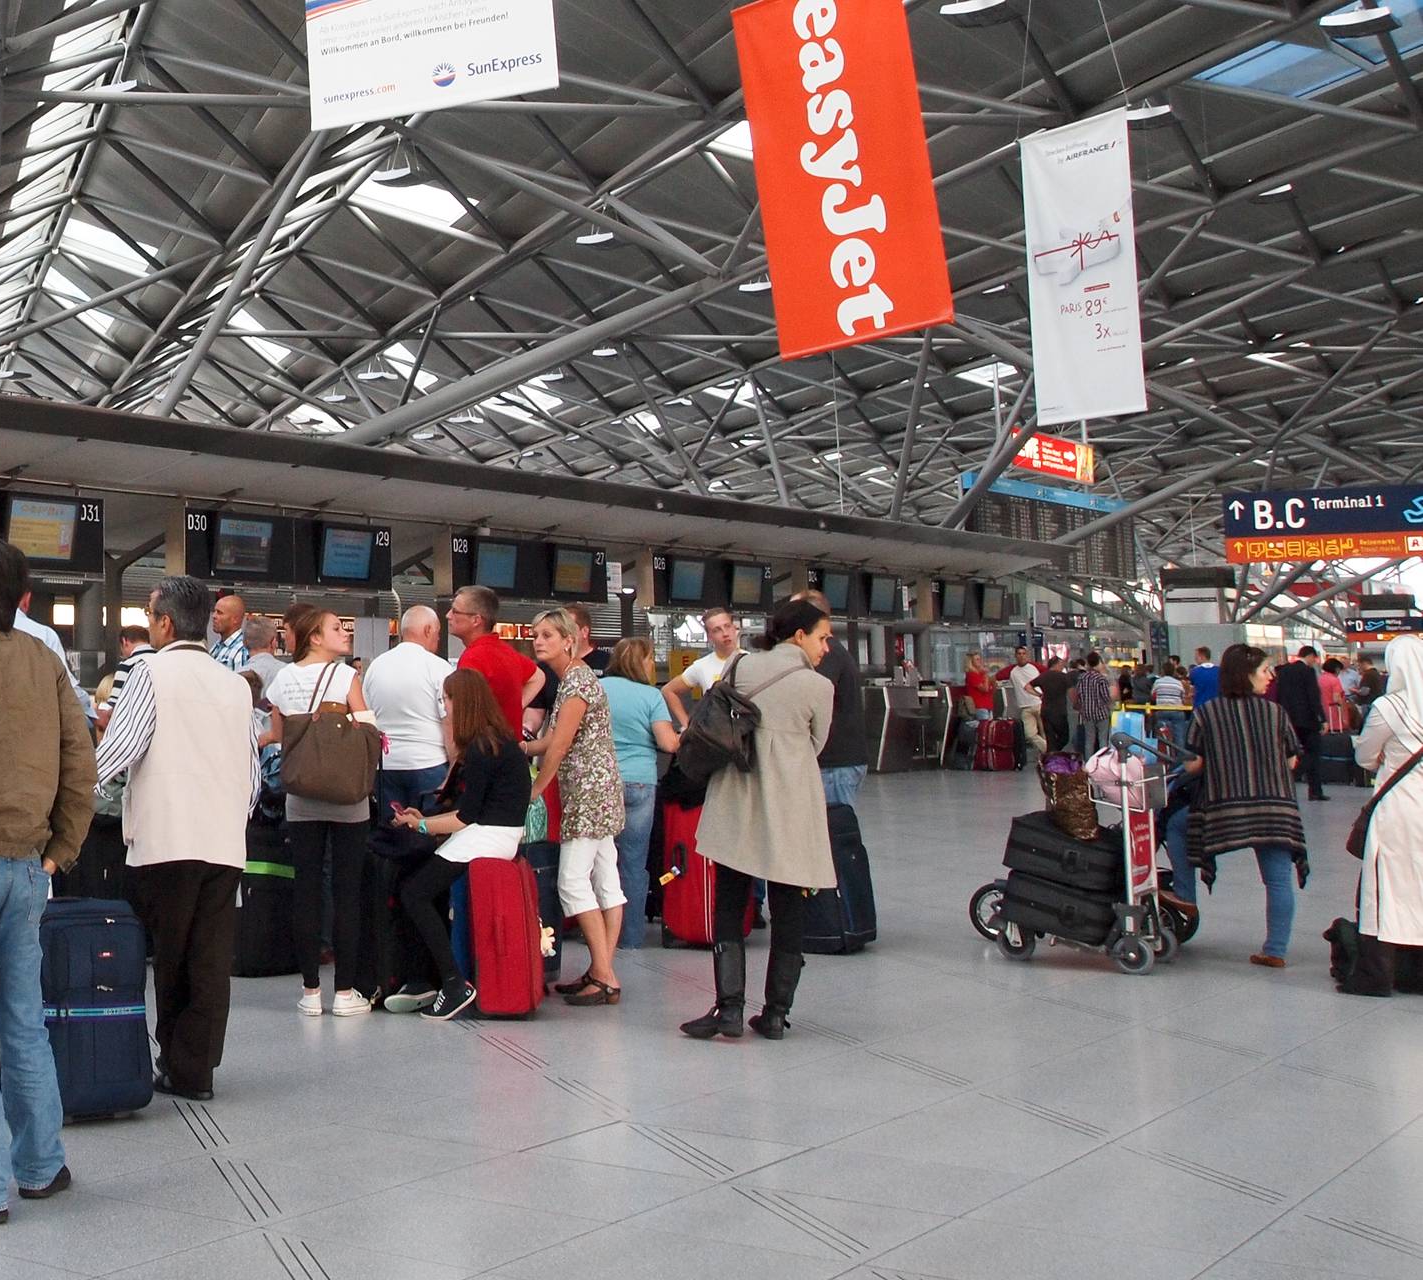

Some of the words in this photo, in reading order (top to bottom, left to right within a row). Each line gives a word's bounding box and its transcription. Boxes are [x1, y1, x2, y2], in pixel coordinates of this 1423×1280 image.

[320, 41, 368, 56] Willkommen
[370, 38, 380, 47] an
[381, 33, 402, 45] Bord,
[403, 24, 452, 40] willkommen
[454, 20, 466, 31] bei
[468, 11, 509, 27] Freunden!
[467, 52, 542, 77] SunExpress
[323, 83, 396, 104] sunexpress.com
[792, 0, 894, 337] easyJet
[1060, 301, 1082, 315] PARIS
[1311, 495, 1373, 510] Terminal
[1375, 495, 1385, 507] 1
[187, 514, 207, 531] D30
[376, 531, 390, 546] 29
[453, 538, 469, 553] D28
